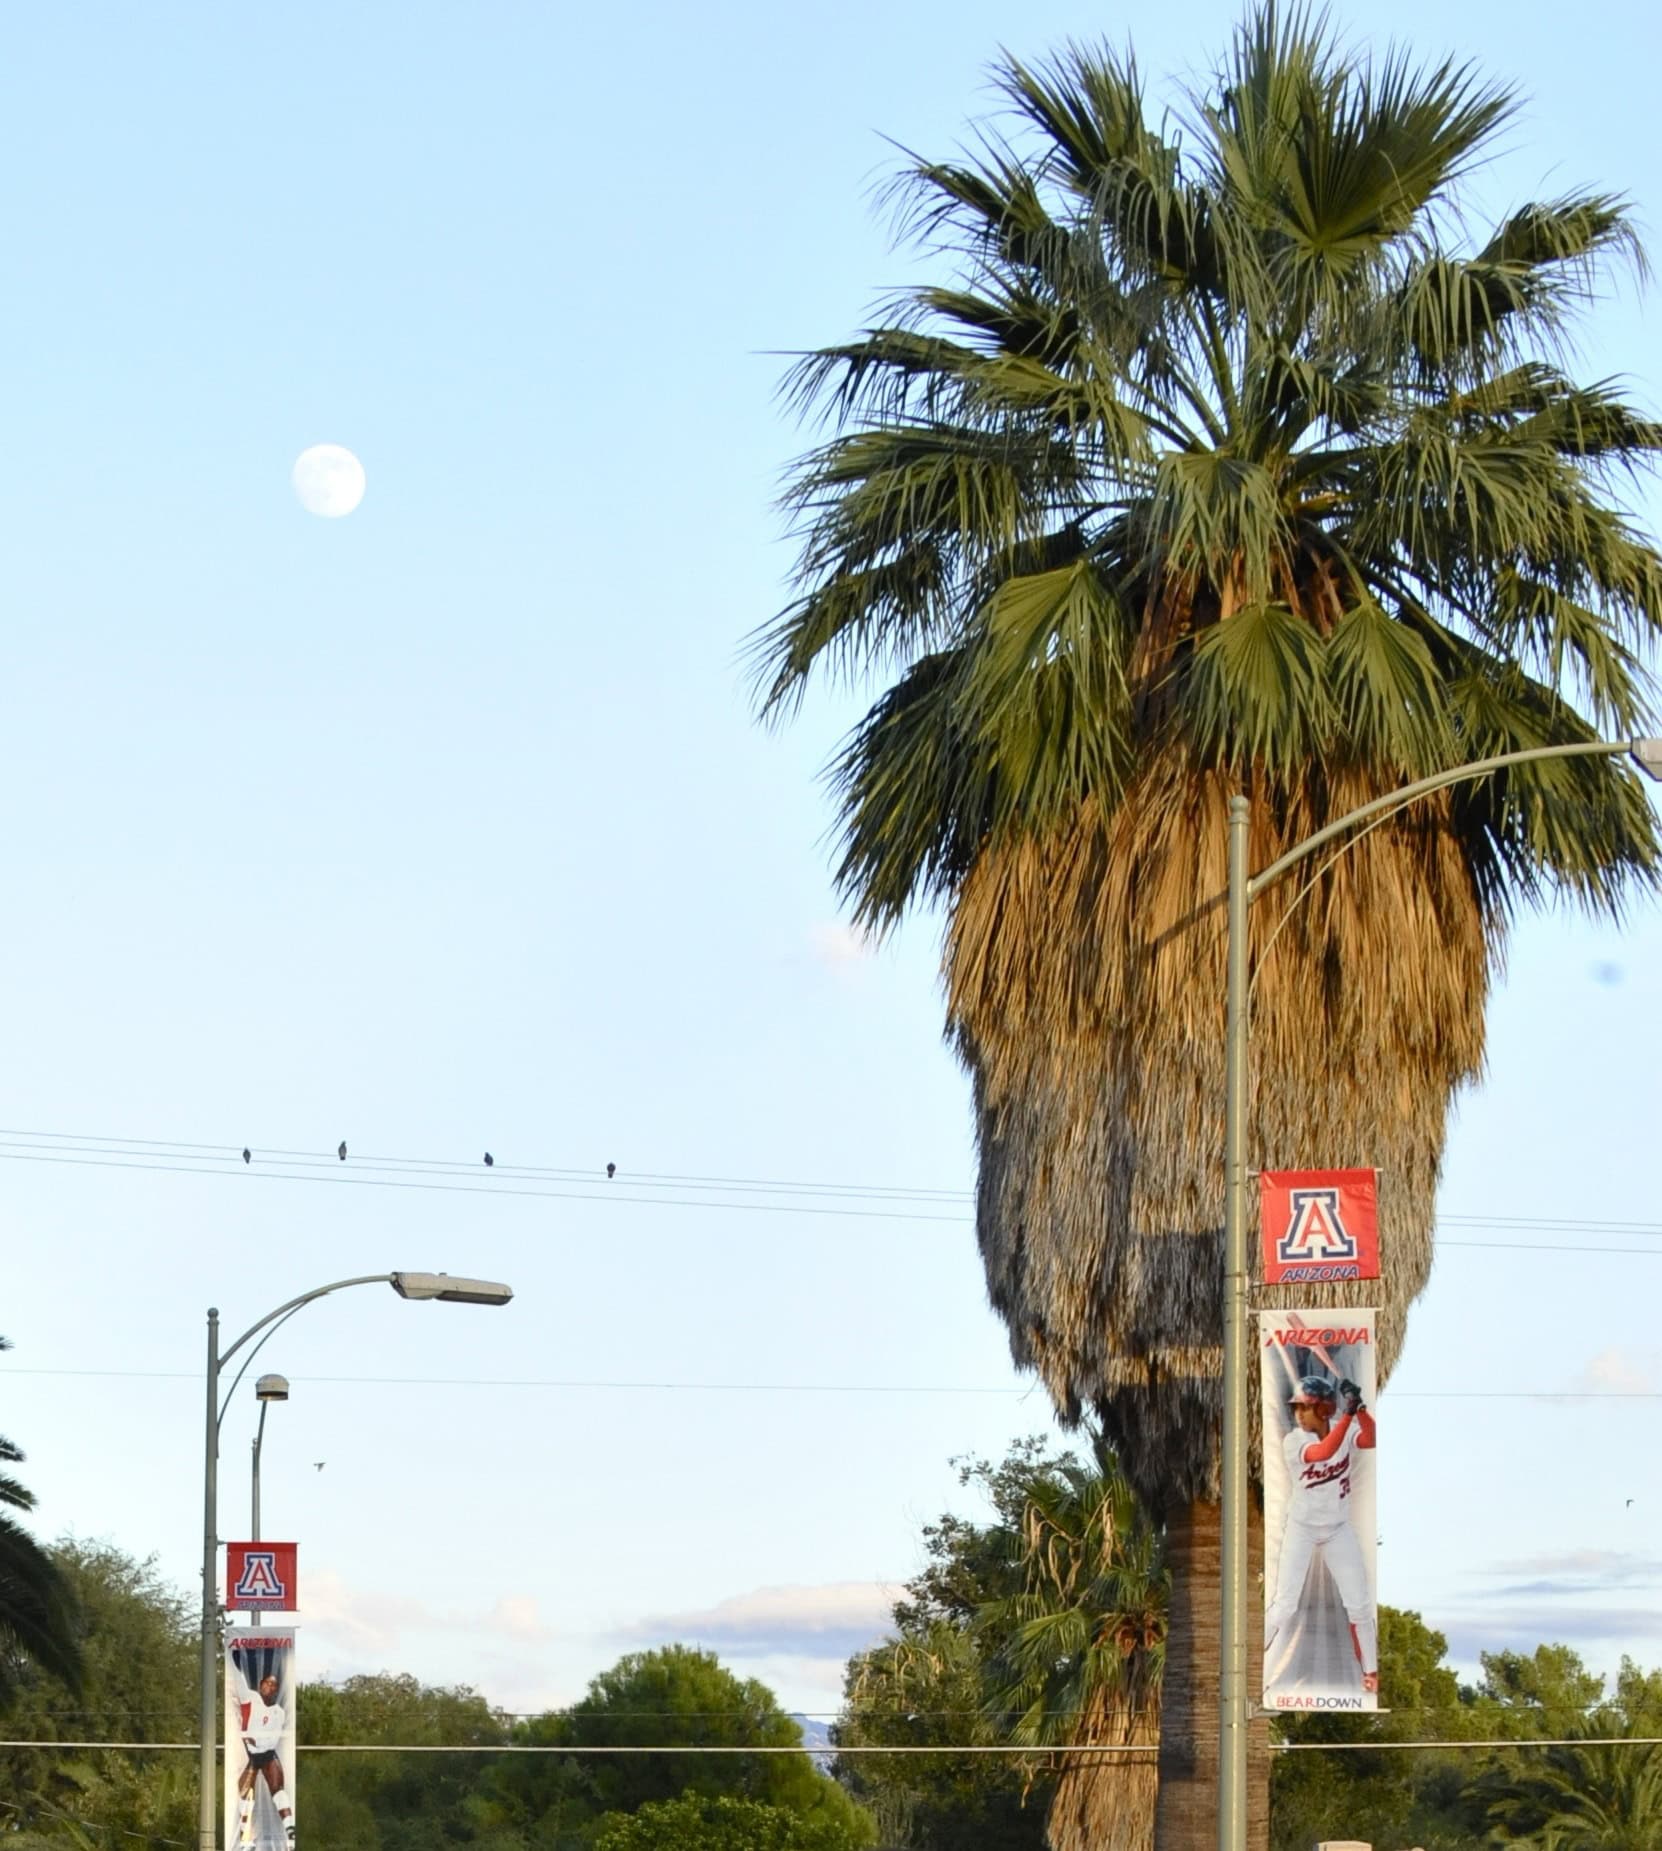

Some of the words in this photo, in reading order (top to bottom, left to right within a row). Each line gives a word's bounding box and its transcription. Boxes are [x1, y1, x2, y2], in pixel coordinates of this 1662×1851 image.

[1276, 1187, 1358, 1264] A
[1280, 1266, 1359, 1282] ARIZONA
[1263, 1327, 1369, 1347] ARIZONA
[235, 1552, 285, 1599] A
[229, 1637, 292, 1649] ARIZONA
[1276, 1696, 1362, 1709] BEARDOWN
